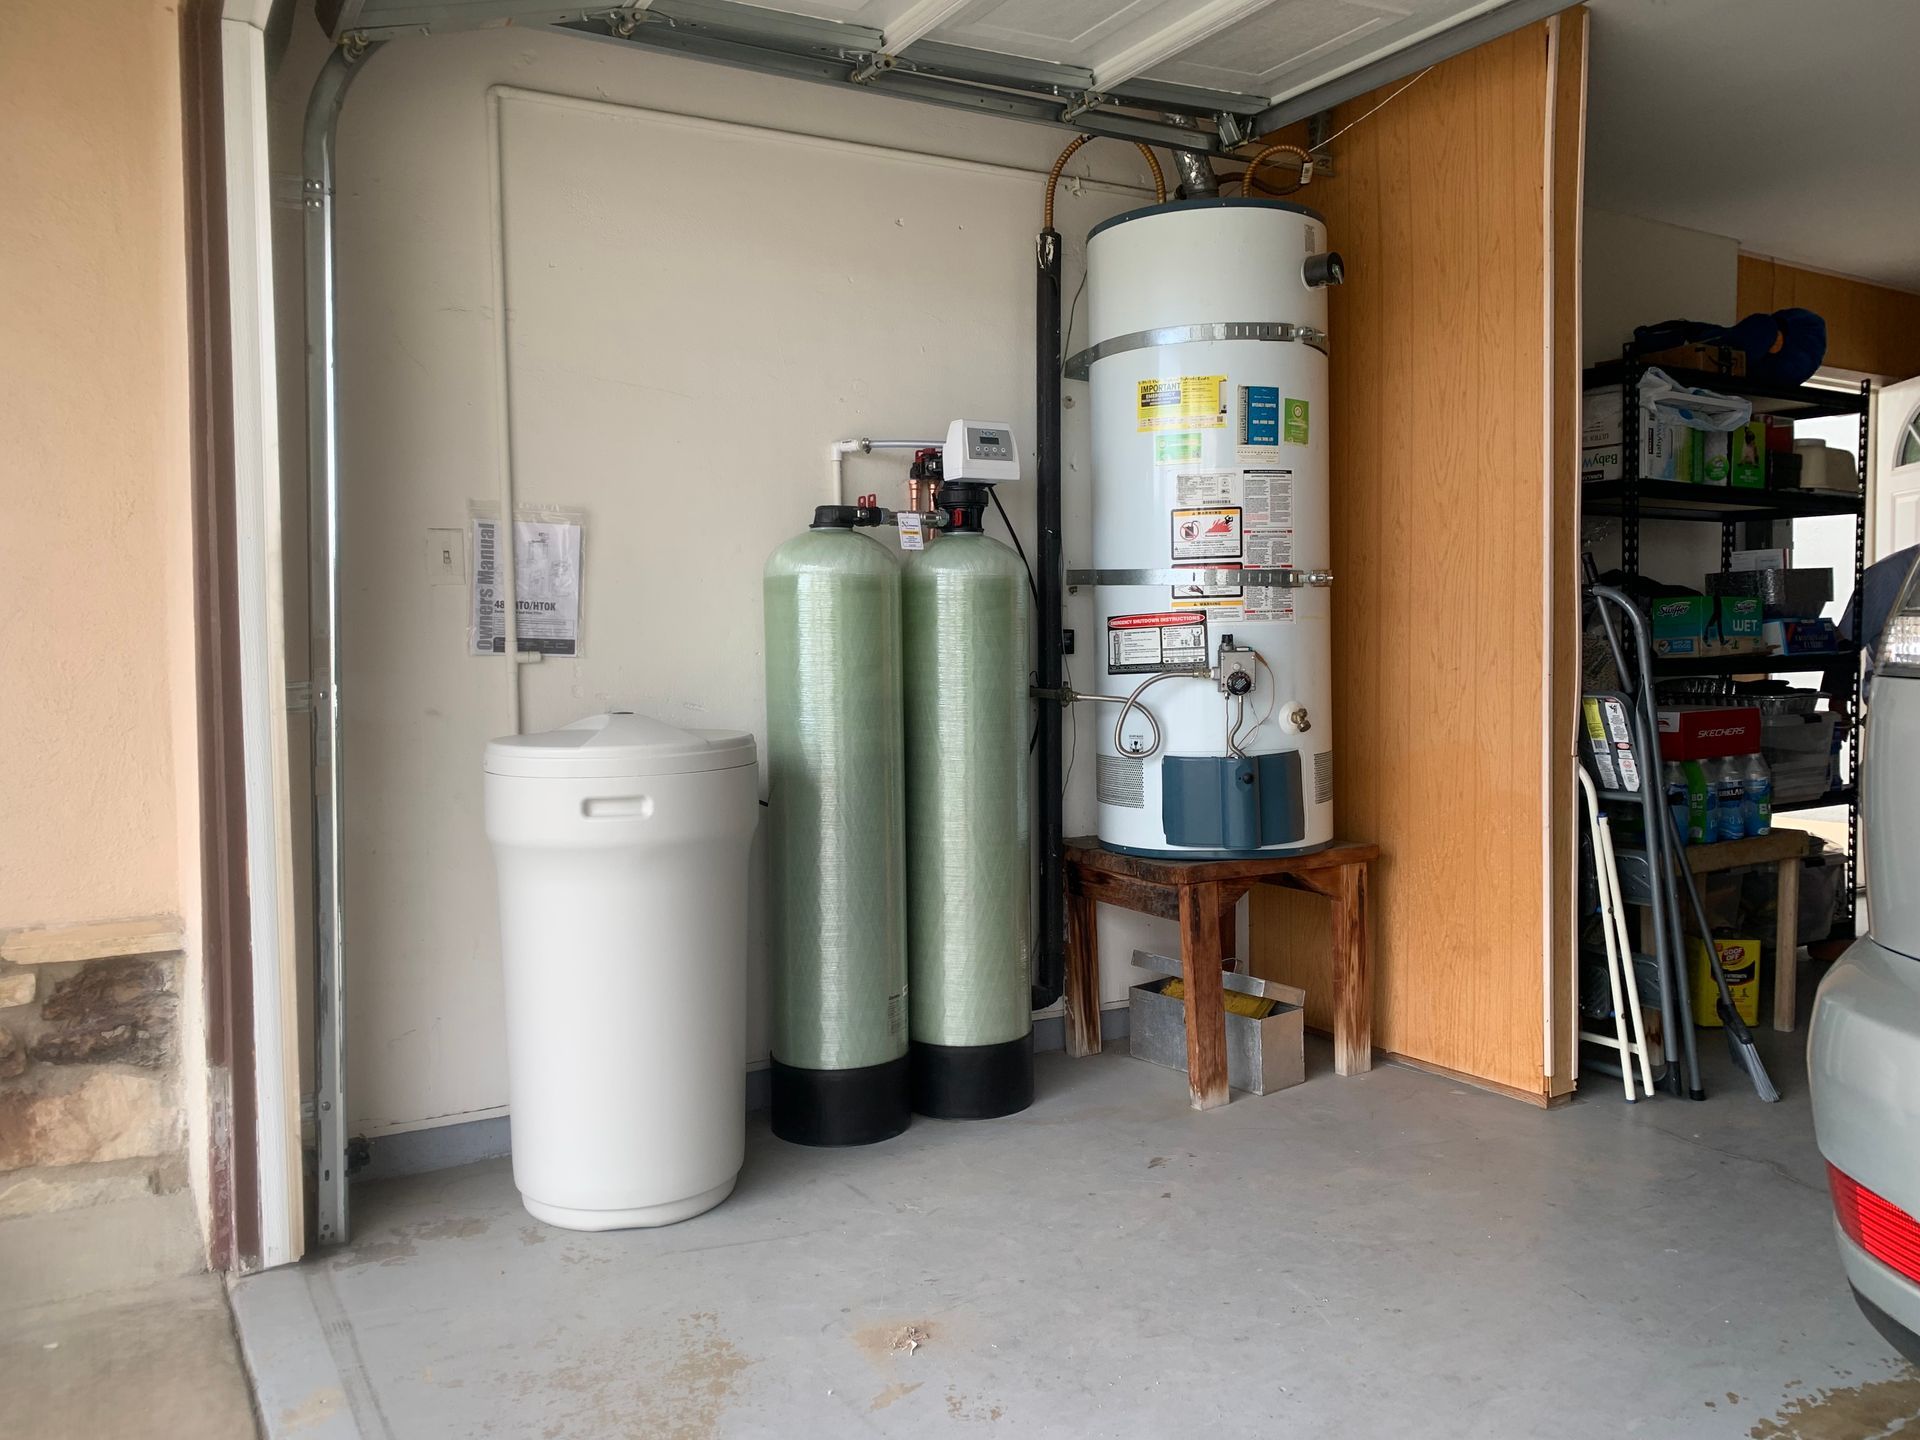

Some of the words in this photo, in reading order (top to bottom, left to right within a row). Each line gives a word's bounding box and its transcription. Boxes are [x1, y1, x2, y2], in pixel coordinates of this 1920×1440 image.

[1140, 382, 1180, 394] IMPORTANT
[477, 523, 495, 585] Manual
[1658, 602, 1690, 617] Swiffer
[477, 588, 494, 650] Owners
[1160, 615, 1200, 623] INSTRUCTIONS
[1732, 619, 1758, 632] WET
[1697, 726, 1746, 738] SKECHERS
[1723, 947, 1743, 956] GOOF
[1726, 953, 1740, 961] OFF
